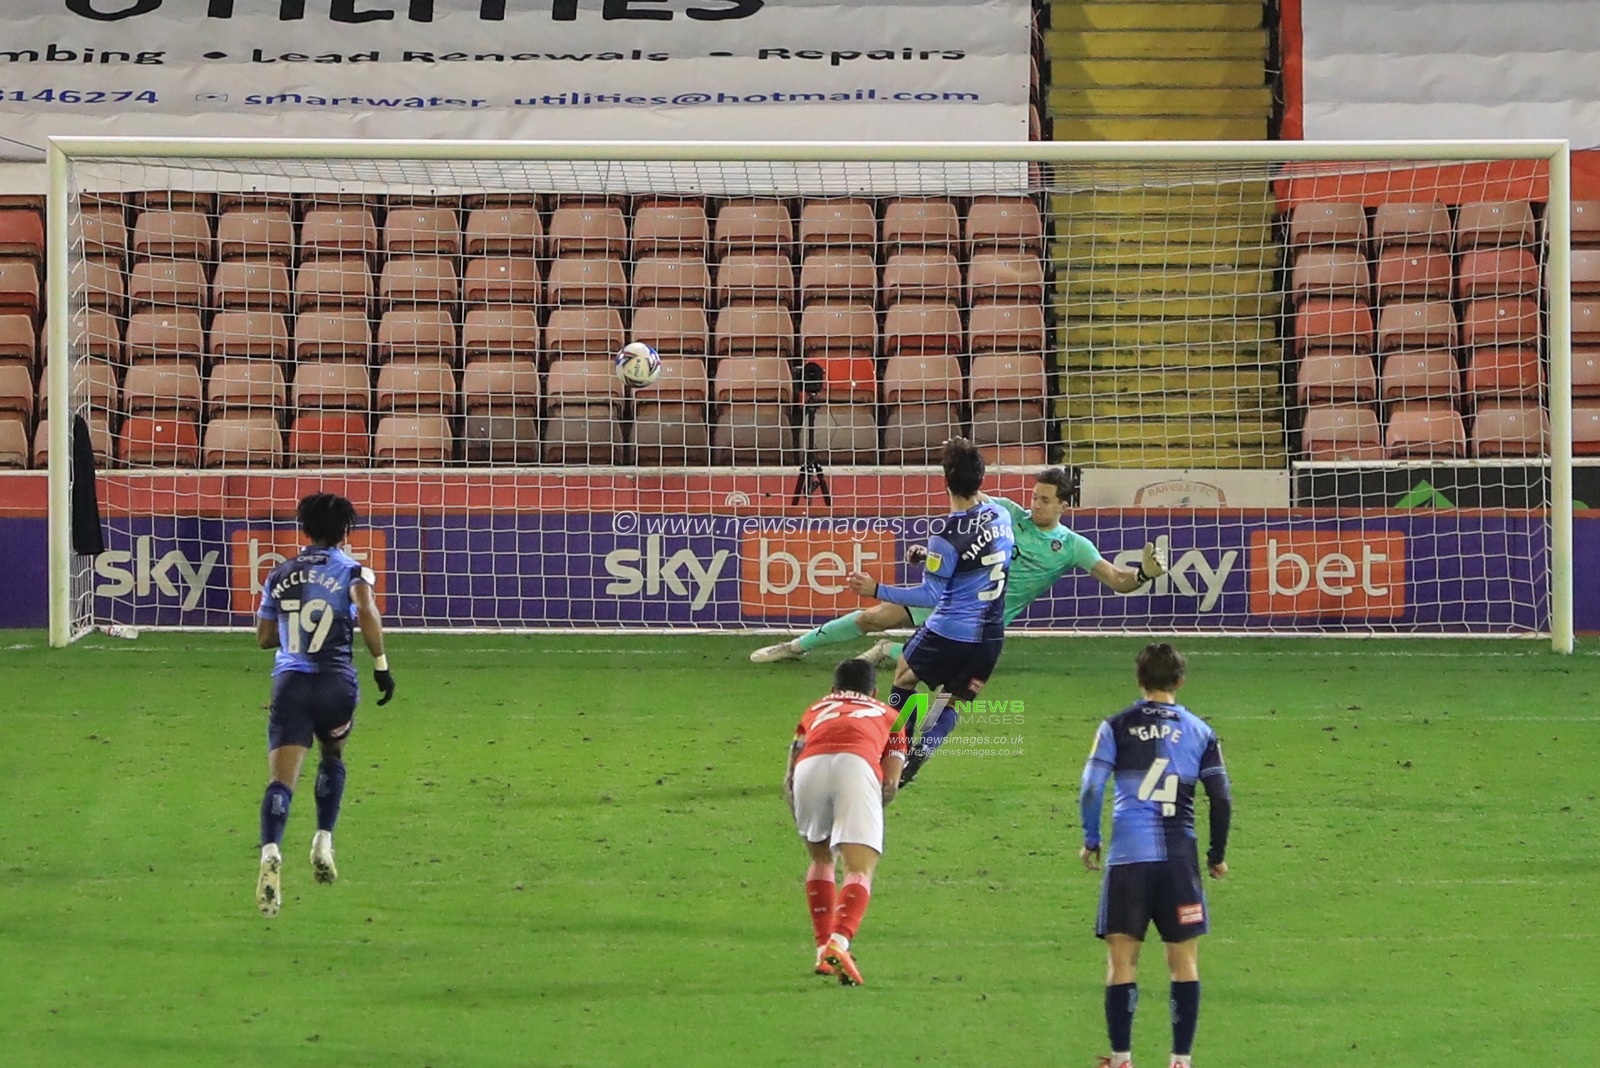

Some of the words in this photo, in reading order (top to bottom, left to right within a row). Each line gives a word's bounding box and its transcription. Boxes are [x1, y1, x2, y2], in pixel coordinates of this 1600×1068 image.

[252, 48, 380, 63] Lead
[402, 50, 670, 63] Renewals
[758, 47, 966, 66] Repairs
[0, 89, 159, 104] 146274
[514, 89, 979, 106] utilities@hotmail.com
[967, 525, 1014, 560] JACOBSO
[1268, 538, 1389, 597] bet
[94, 535, 219, 612] sky
[604, 534, 730, 611] sky
[759, 538, 878, 595] bet
[978, 550, 1006, 601] 3
[280, 598, 334, 654] 19
[1138, 725, 1182, 743] GAPE
[1138, 758, 1179, 817] 4
